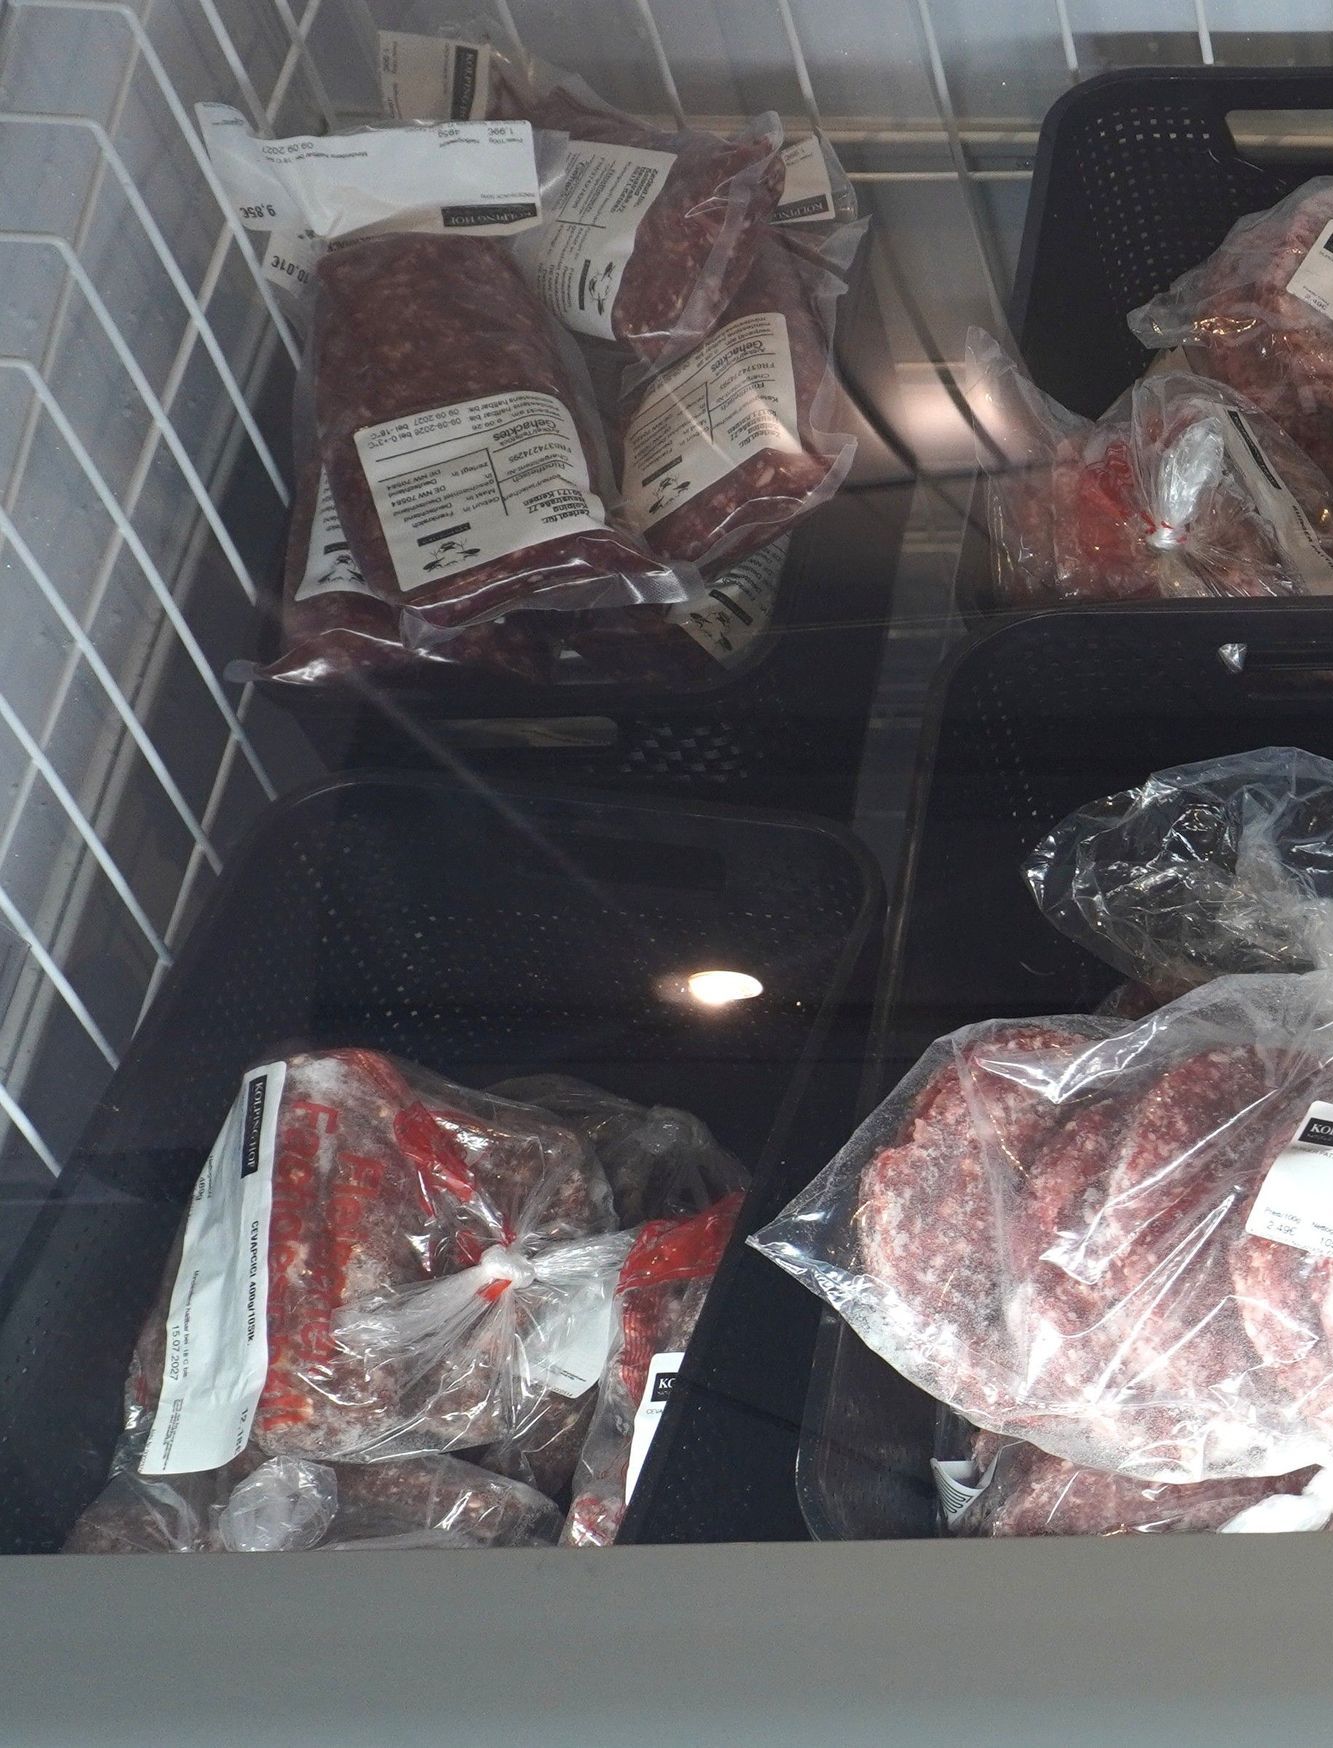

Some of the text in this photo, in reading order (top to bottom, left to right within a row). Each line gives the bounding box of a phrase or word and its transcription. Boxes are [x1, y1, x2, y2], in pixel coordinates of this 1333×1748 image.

[240, 204, 276, 218] 9,85€
[271, 256, 310, 284] 10,01€
[492, 420, 556, 442] Gehacktes
[246, 1081, 264, 1168] KOLPING HOF
[248, 1220, 259, 1278] CEVAPCICI
[169, 1325, 181, 1381] 15.07.2027
